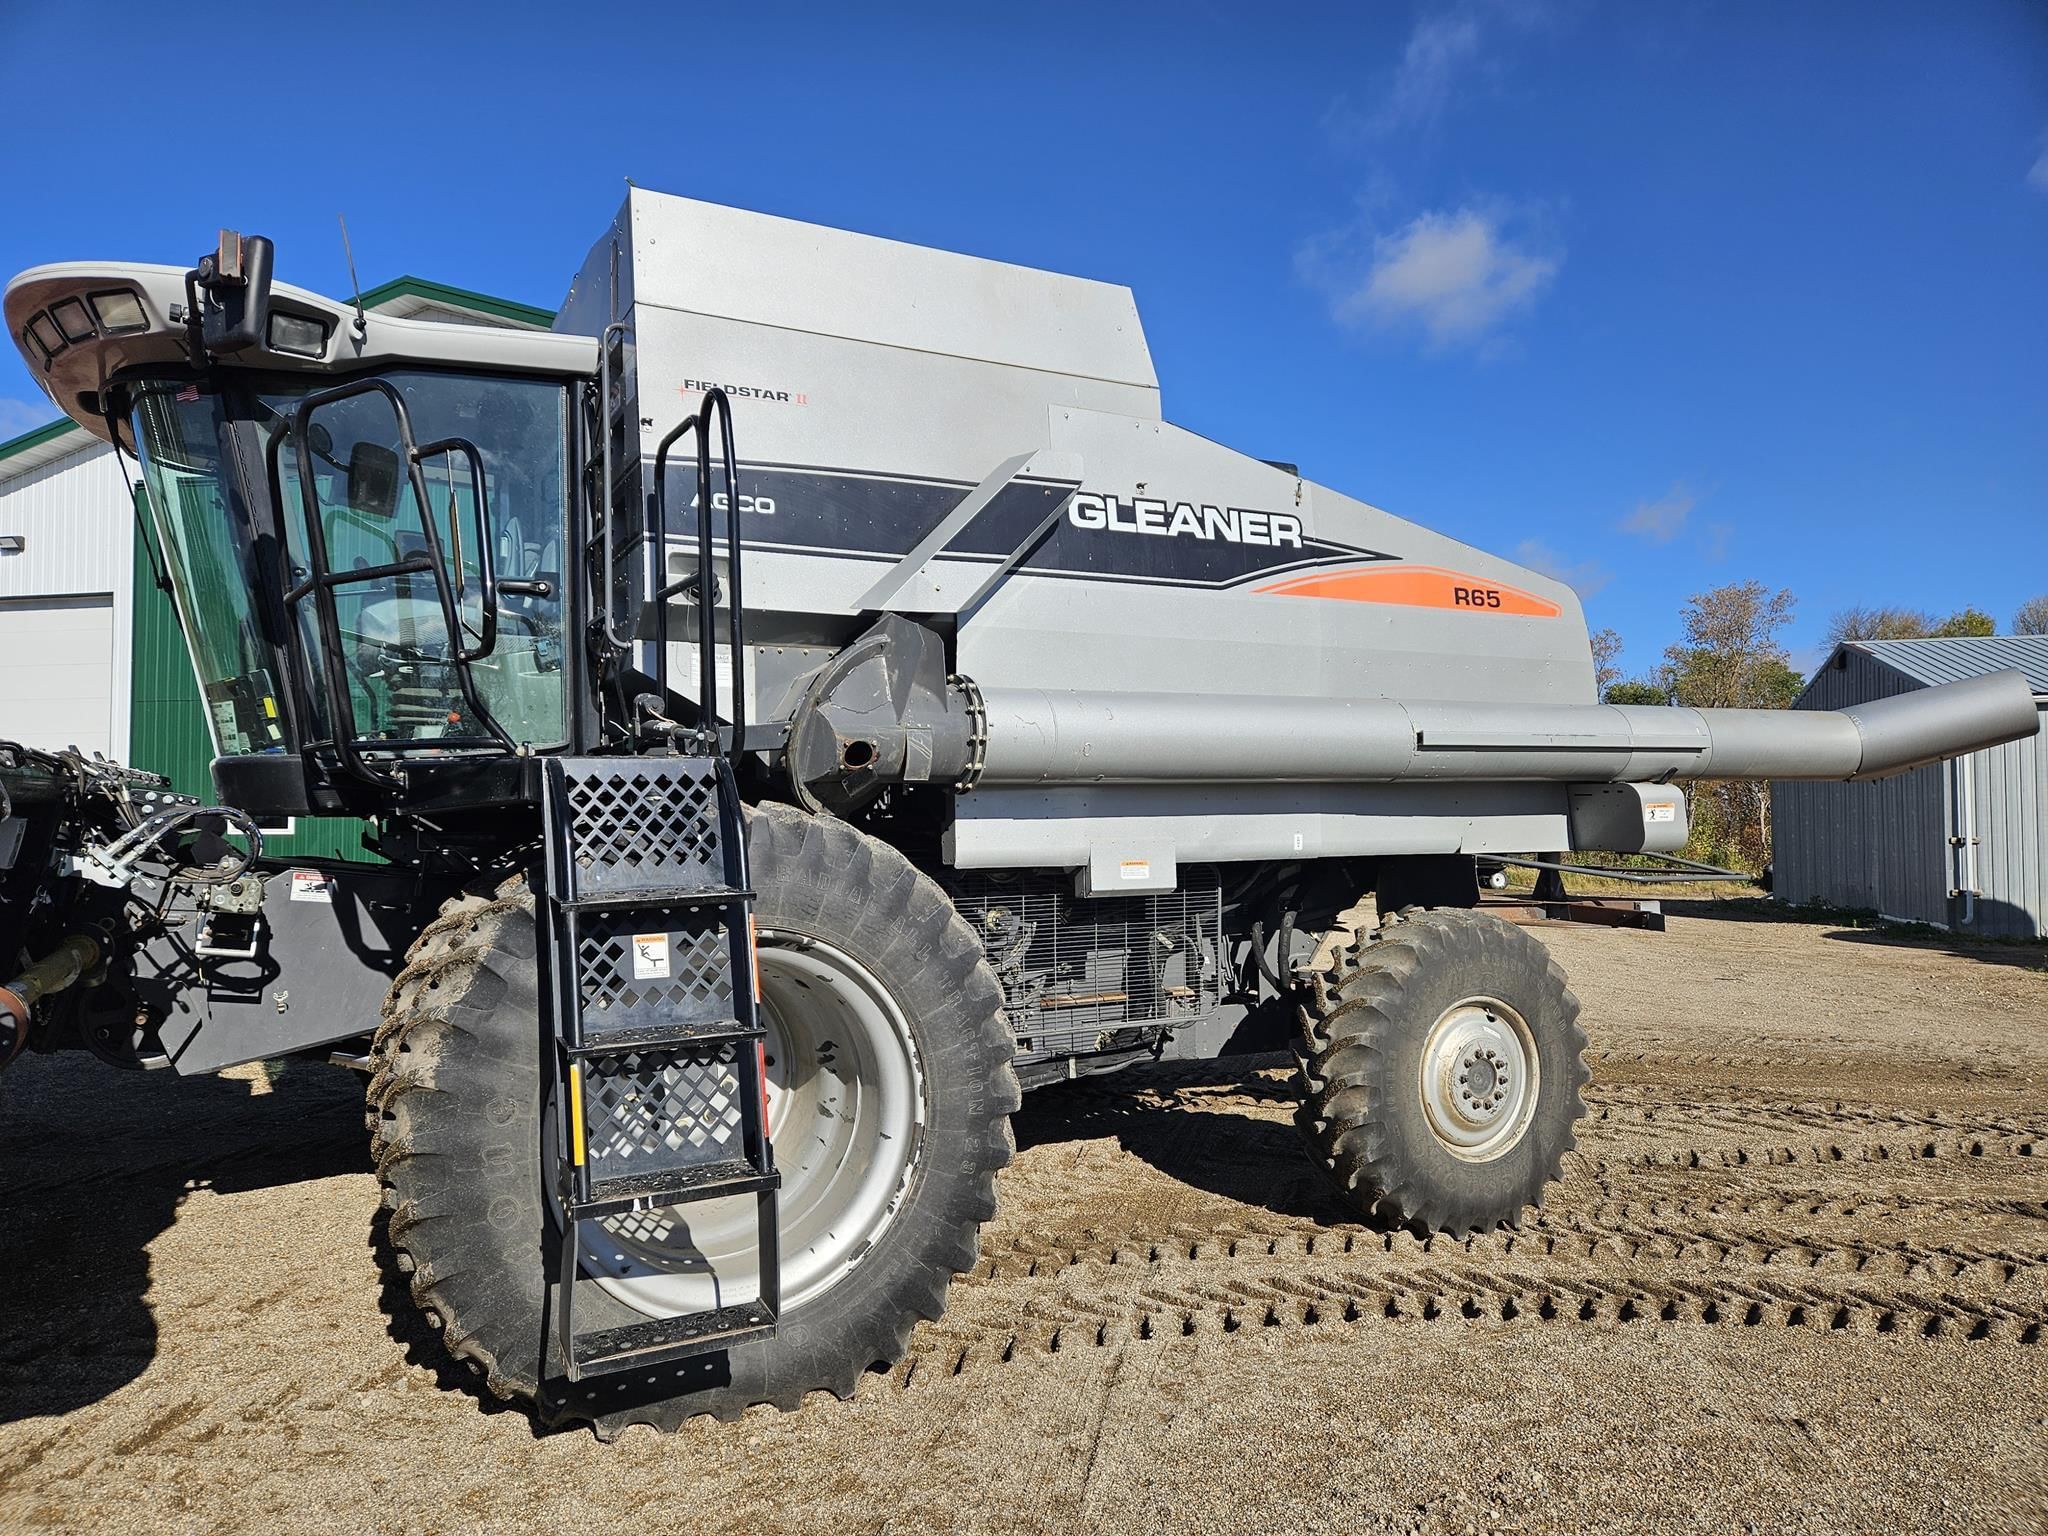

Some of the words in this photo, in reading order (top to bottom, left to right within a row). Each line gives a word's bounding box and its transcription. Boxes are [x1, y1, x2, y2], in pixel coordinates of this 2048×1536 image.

[684, 378, 789, 402] FIEDSTAR
[1068, 494, 1302, 548] GLEANER
[1454, 587, 1501, 608] R65
[938, 968, 985, 1116] TRACTION
